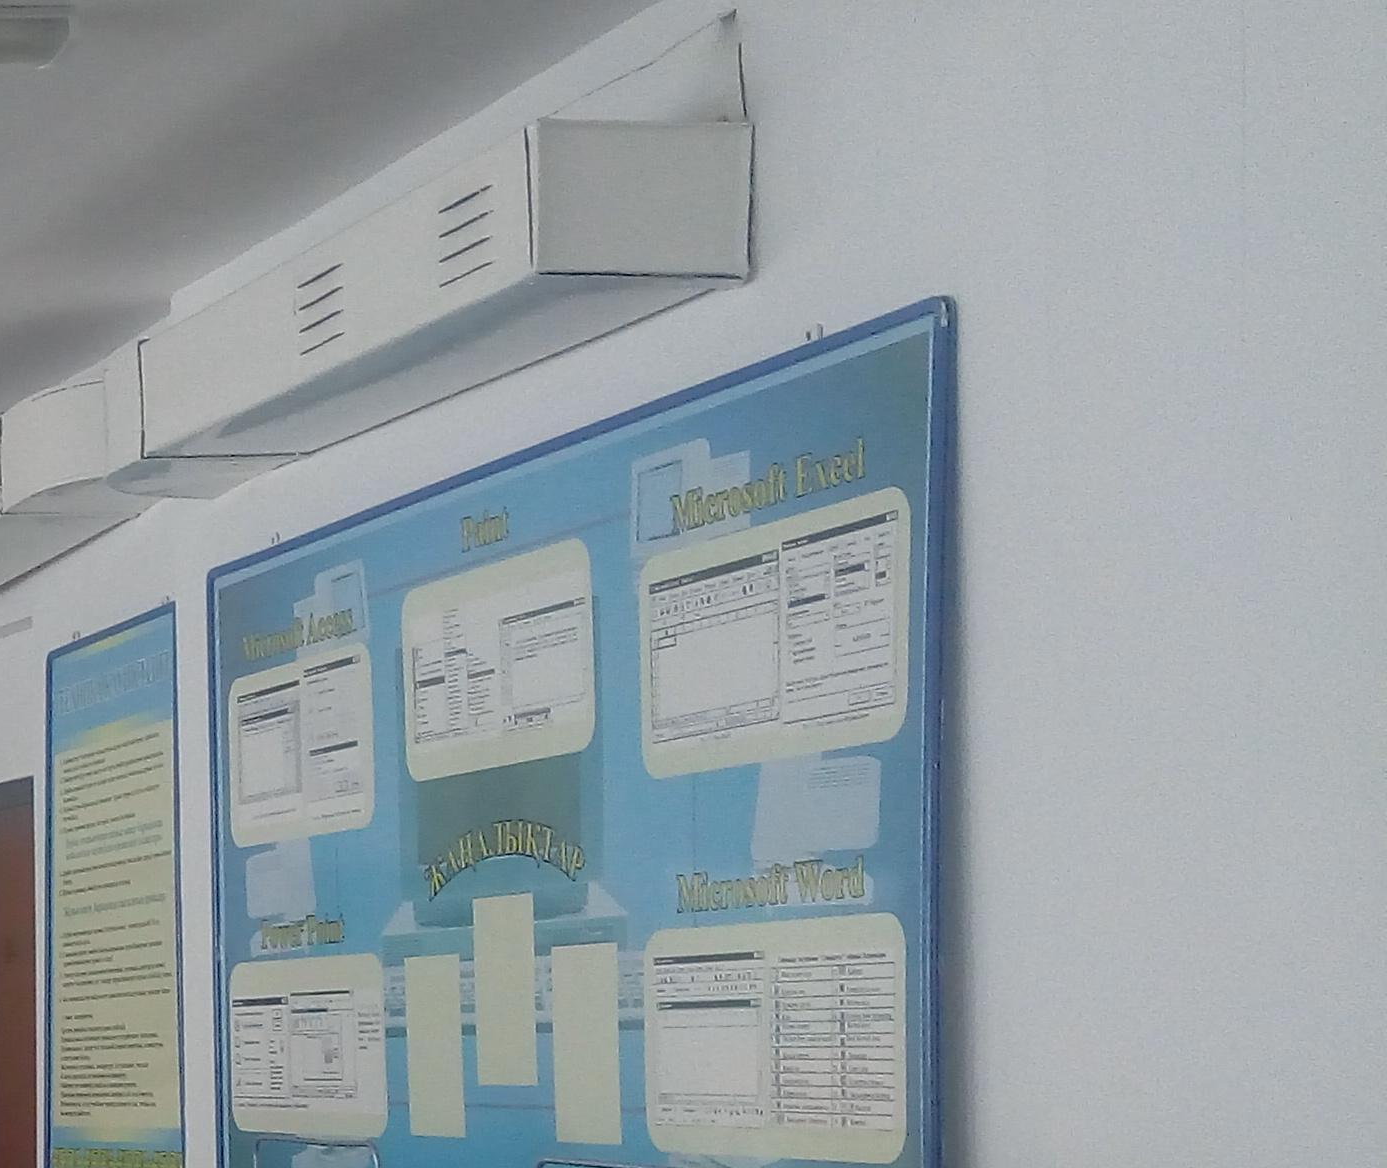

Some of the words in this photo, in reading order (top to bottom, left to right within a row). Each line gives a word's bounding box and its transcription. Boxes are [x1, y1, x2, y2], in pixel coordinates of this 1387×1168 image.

[670, 462, 787, 535] Microsoft
[795, 436, 866, 498] Excel
[460, 506, 509, 553] Paint
[242, 616, 304, 662] Microsoft
[676, 862, 790, 913] Microsoft
[793, 855, 866, 902] Word
